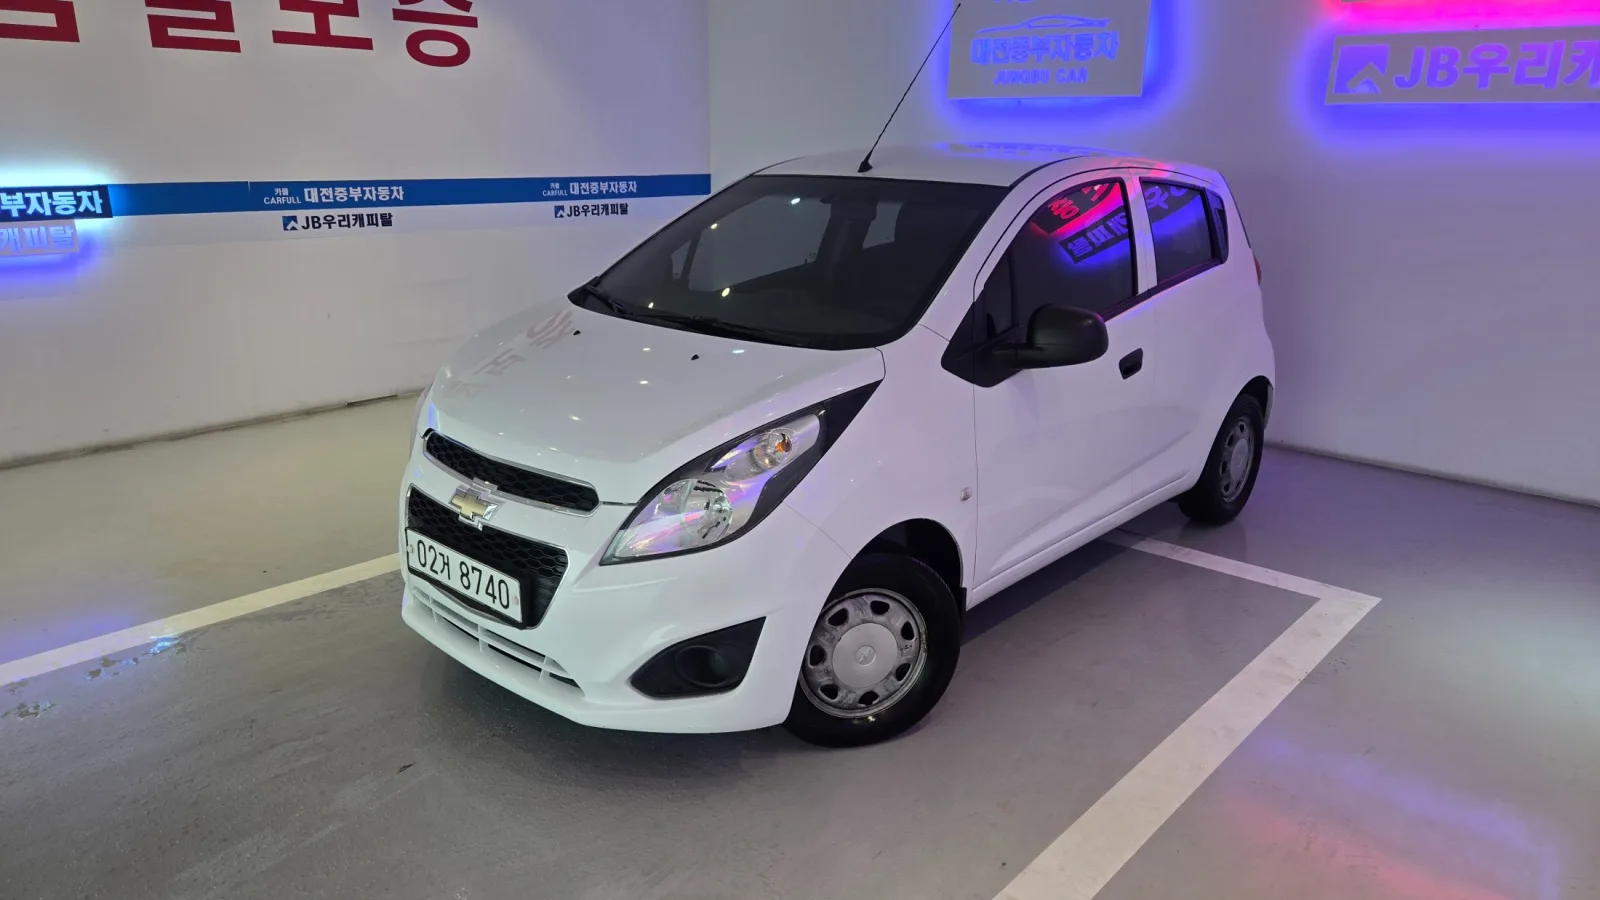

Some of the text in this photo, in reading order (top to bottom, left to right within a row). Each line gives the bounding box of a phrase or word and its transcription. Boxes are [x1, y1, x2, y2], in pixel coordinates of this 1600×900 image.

[970, 31, 1120, 65] 대전중부자동차
[1056, 67, 1089, 84] CAR
[303, 186, 405, 203] 대전중부자동차
[569, 181, 638, 195] 대전중부자동차
[263, 196, 302, 205] CARFULL
[567, 203, 629, 217] JB우리캐피탈
[301, 213, 393, 230] JB우리캐피탈
[417, 539, 510, 610] 02거 8740
